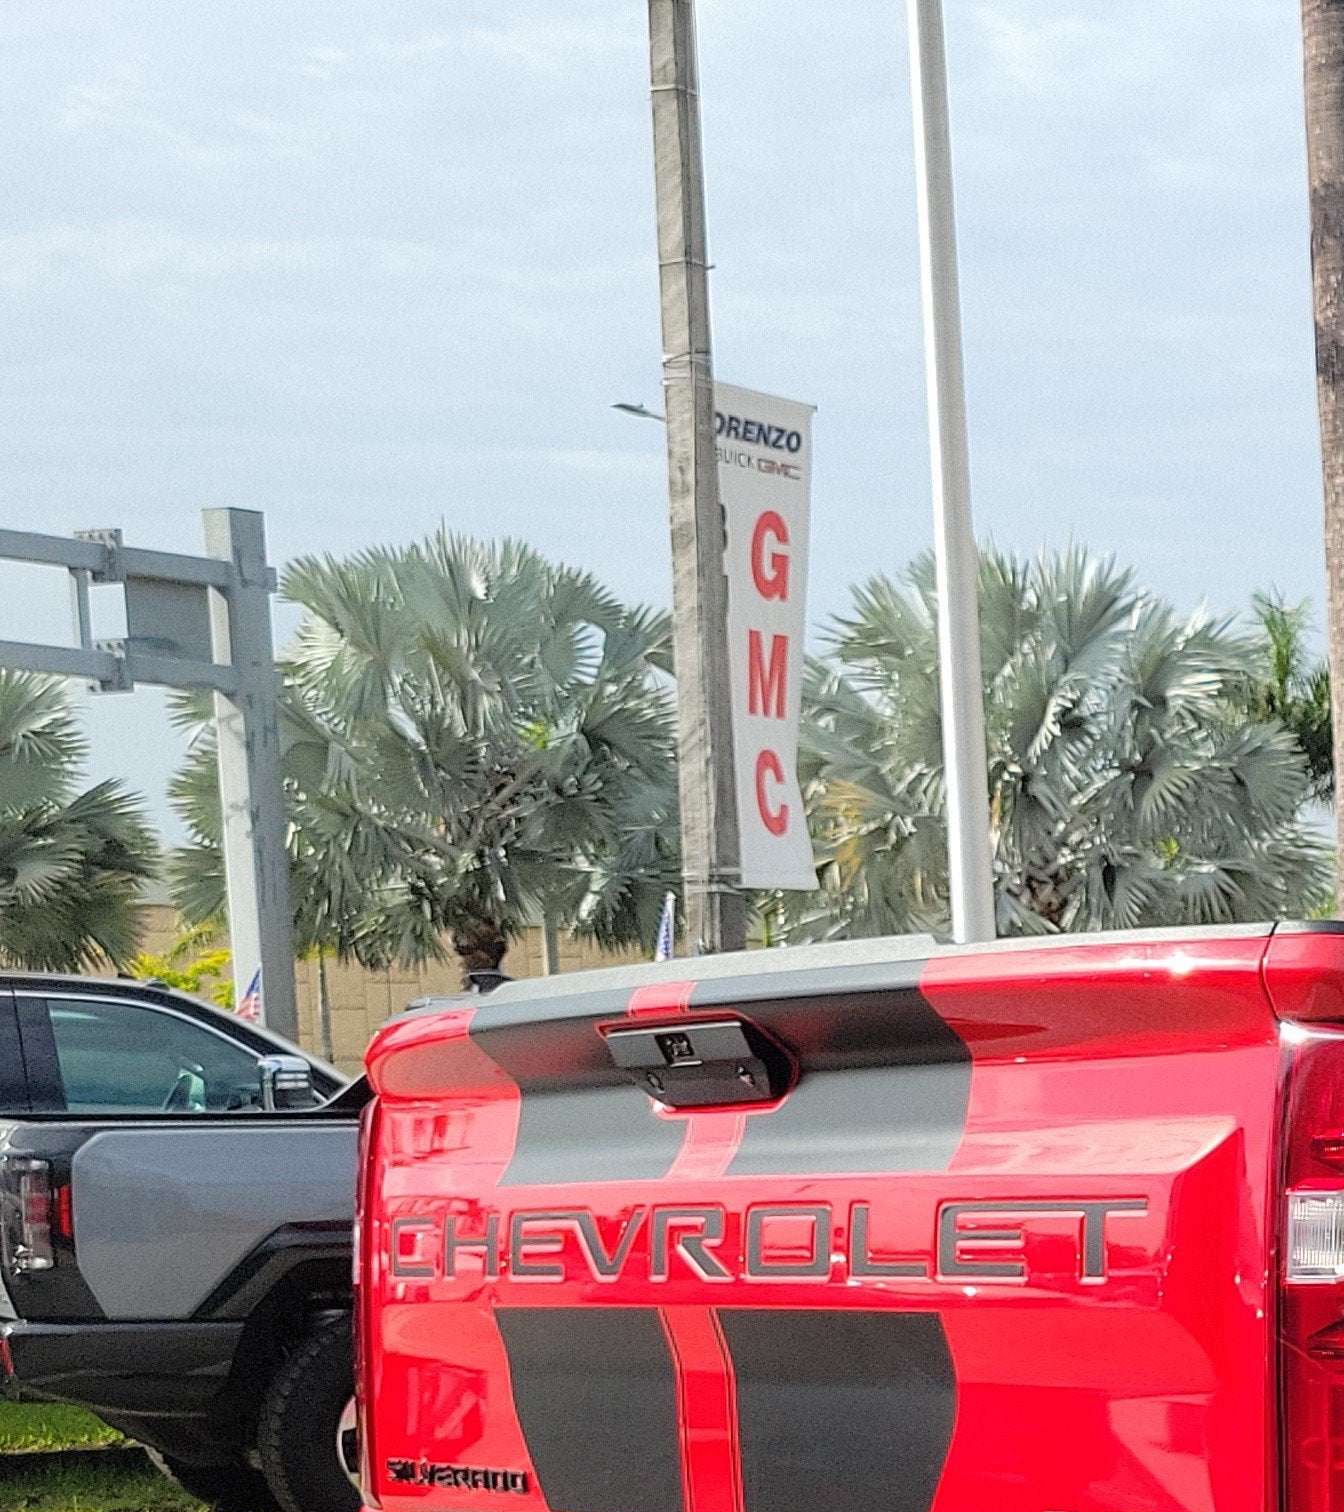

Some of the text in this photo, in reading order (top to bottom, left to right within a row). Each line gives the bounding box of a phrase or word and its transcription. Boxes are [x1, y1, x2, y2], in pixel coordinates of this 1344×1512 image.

[714, 411, 802, 453] ORENZO
[757, 458, 801, 480] GMC
[391, 1199, 1149, 1281] CHEVROLET
[387, 1459, 528, 1495] SILVERADO
